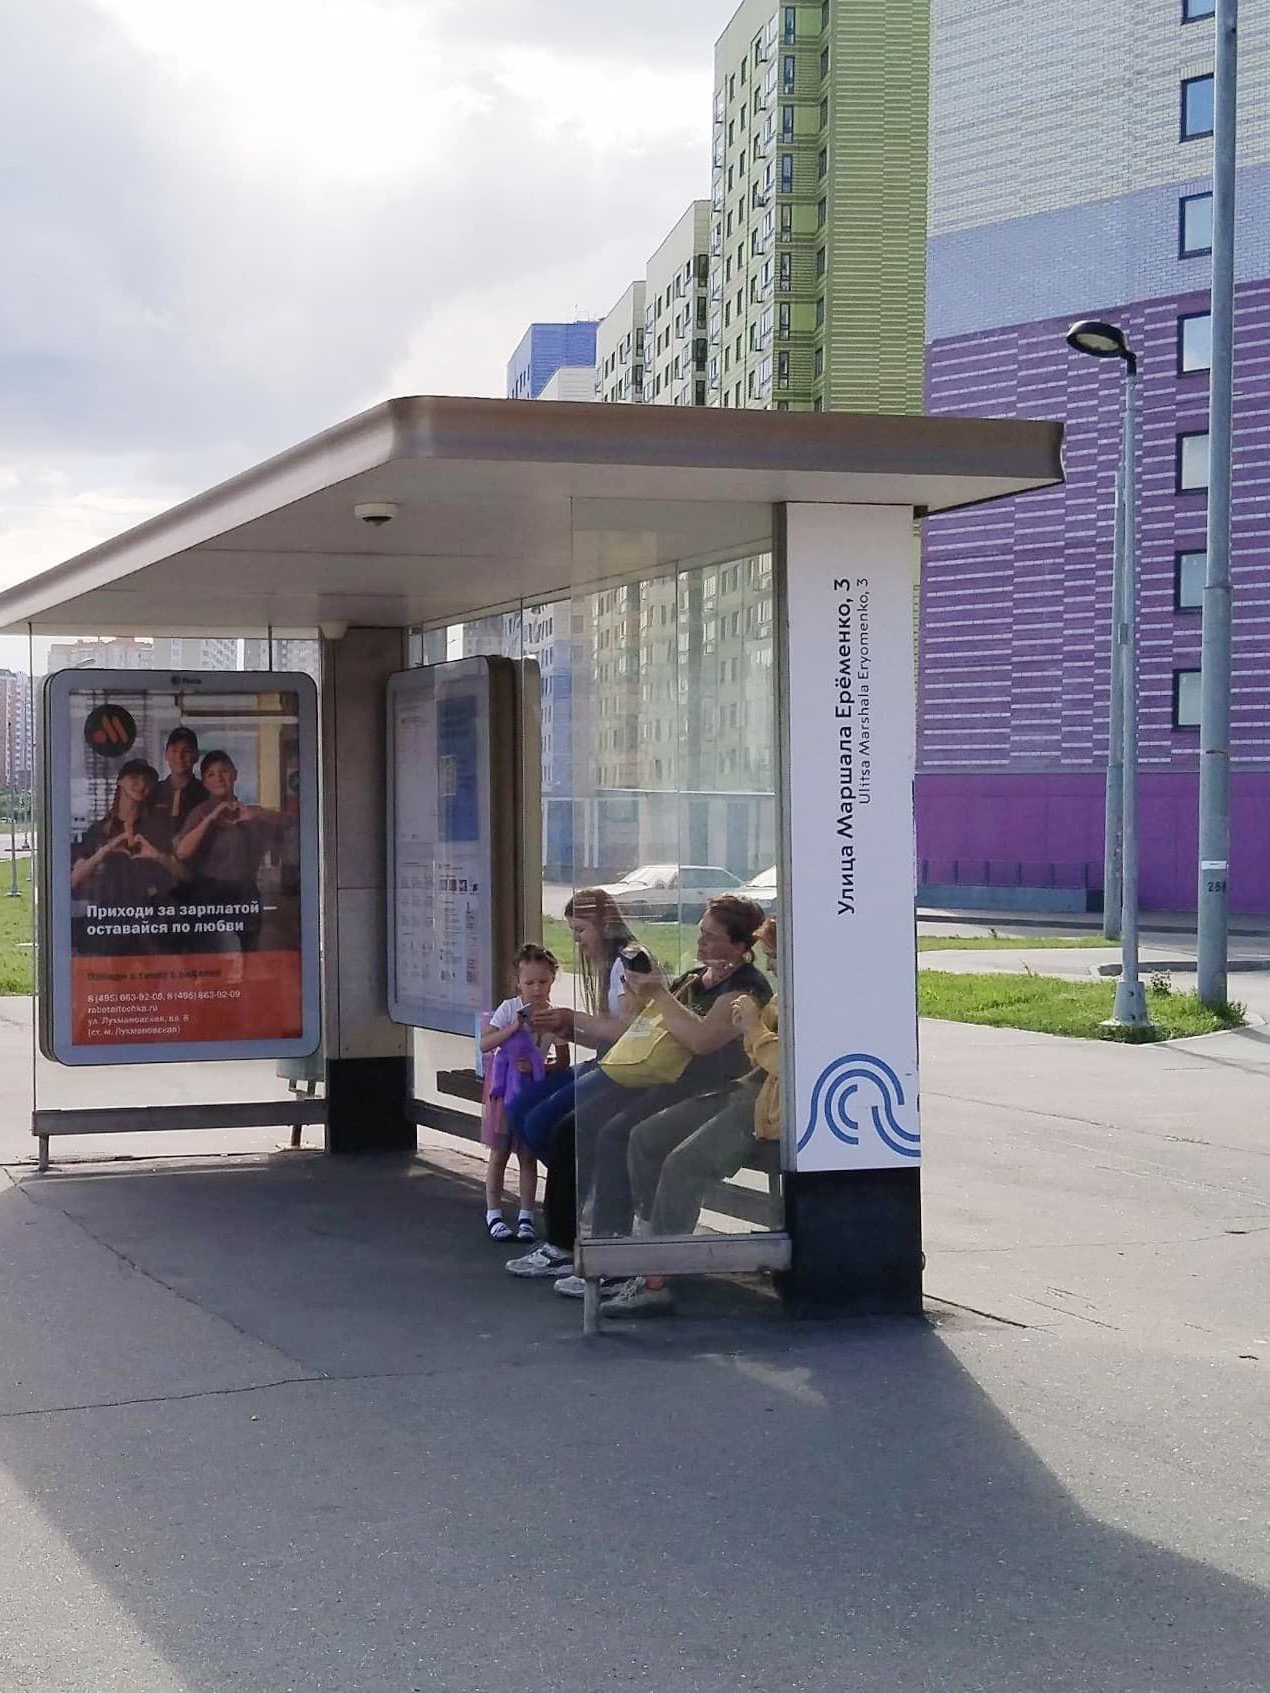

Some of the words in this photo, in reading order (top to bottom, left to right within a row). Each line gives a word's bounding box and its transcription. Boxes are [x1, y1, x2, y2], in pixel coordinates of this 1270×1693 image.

[834, 578, 850, 591] 3
[857, 578, 868, 587] 3
[834, 598, 855, 718] Ерёменко,
[857, 591, 871, 680] Eryomenko,
[857, 684, 871, 756] Marshala
[836, 726, 857, 839] Маршала
[858, 760, 871, 804] Ulitsa
[837, 845, 856, 915] Улица
[86, 905, 154, 919] Приходи
[157, 905, 176, 916] за
[179, 901, 260, 917] зарплатой
[86, 920, 168, 935] оставайся
[172, 922, 191, 933] по
[194, 919, 245, 932] любви
